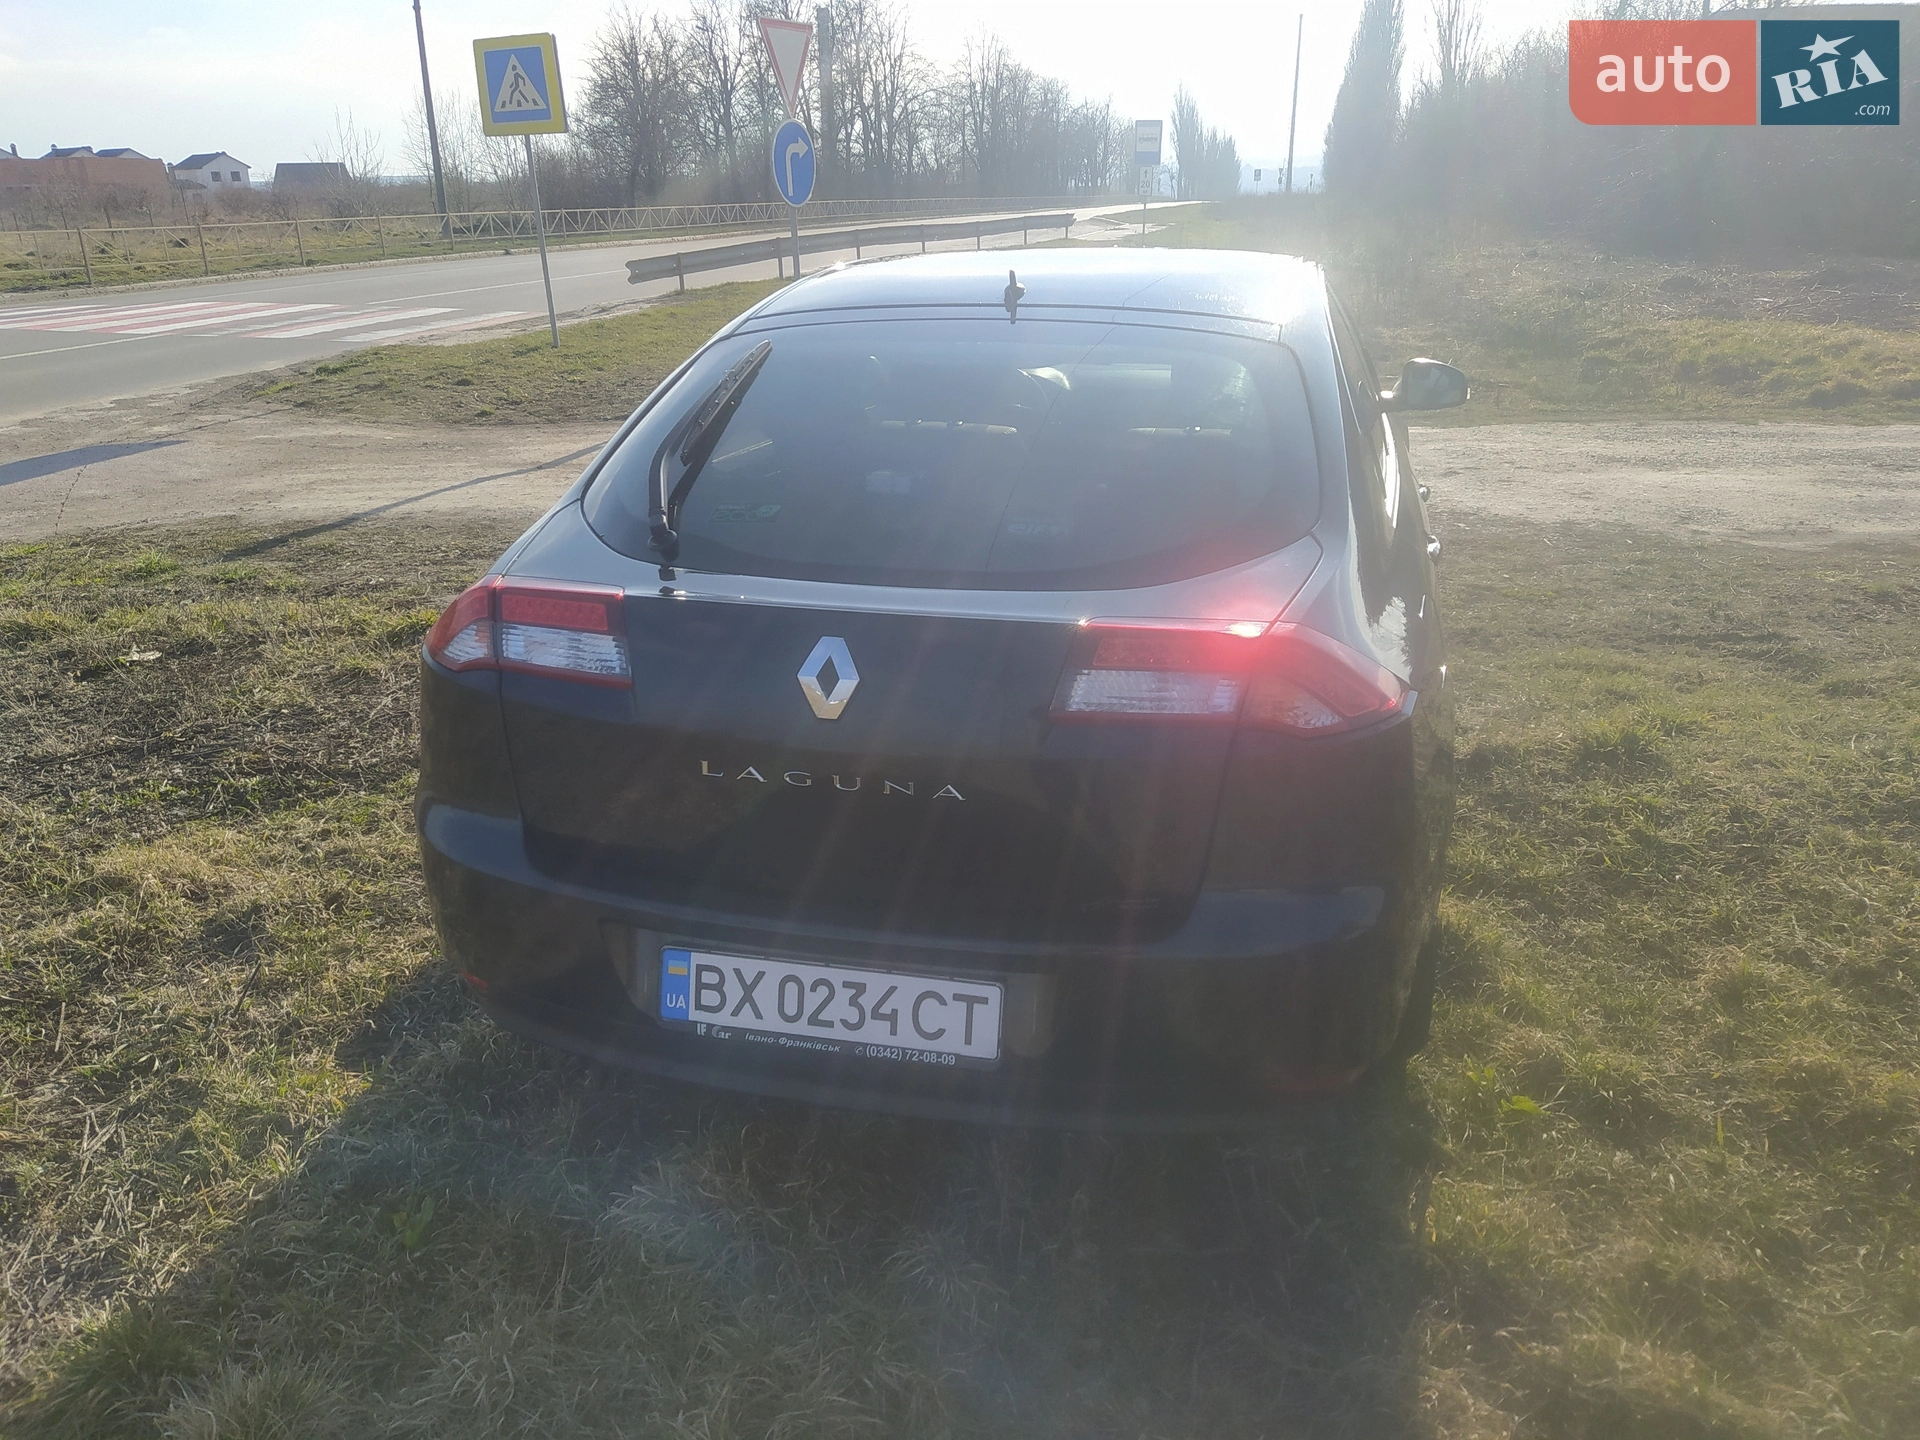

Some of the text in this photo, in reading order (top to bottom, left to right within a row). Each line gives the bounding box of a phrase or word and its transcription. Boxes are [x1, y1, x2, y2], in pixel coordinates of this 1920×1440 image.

[1140, 180, 1150, 188] 20
[700, 760, 966, 800] LAGUNA
[666, 991, 687, 1009] UA
[711, 1026, 732, 1039] Car
[744, 1032, 956, 1065] Івано-Франківськ (0342) 72-08-09
